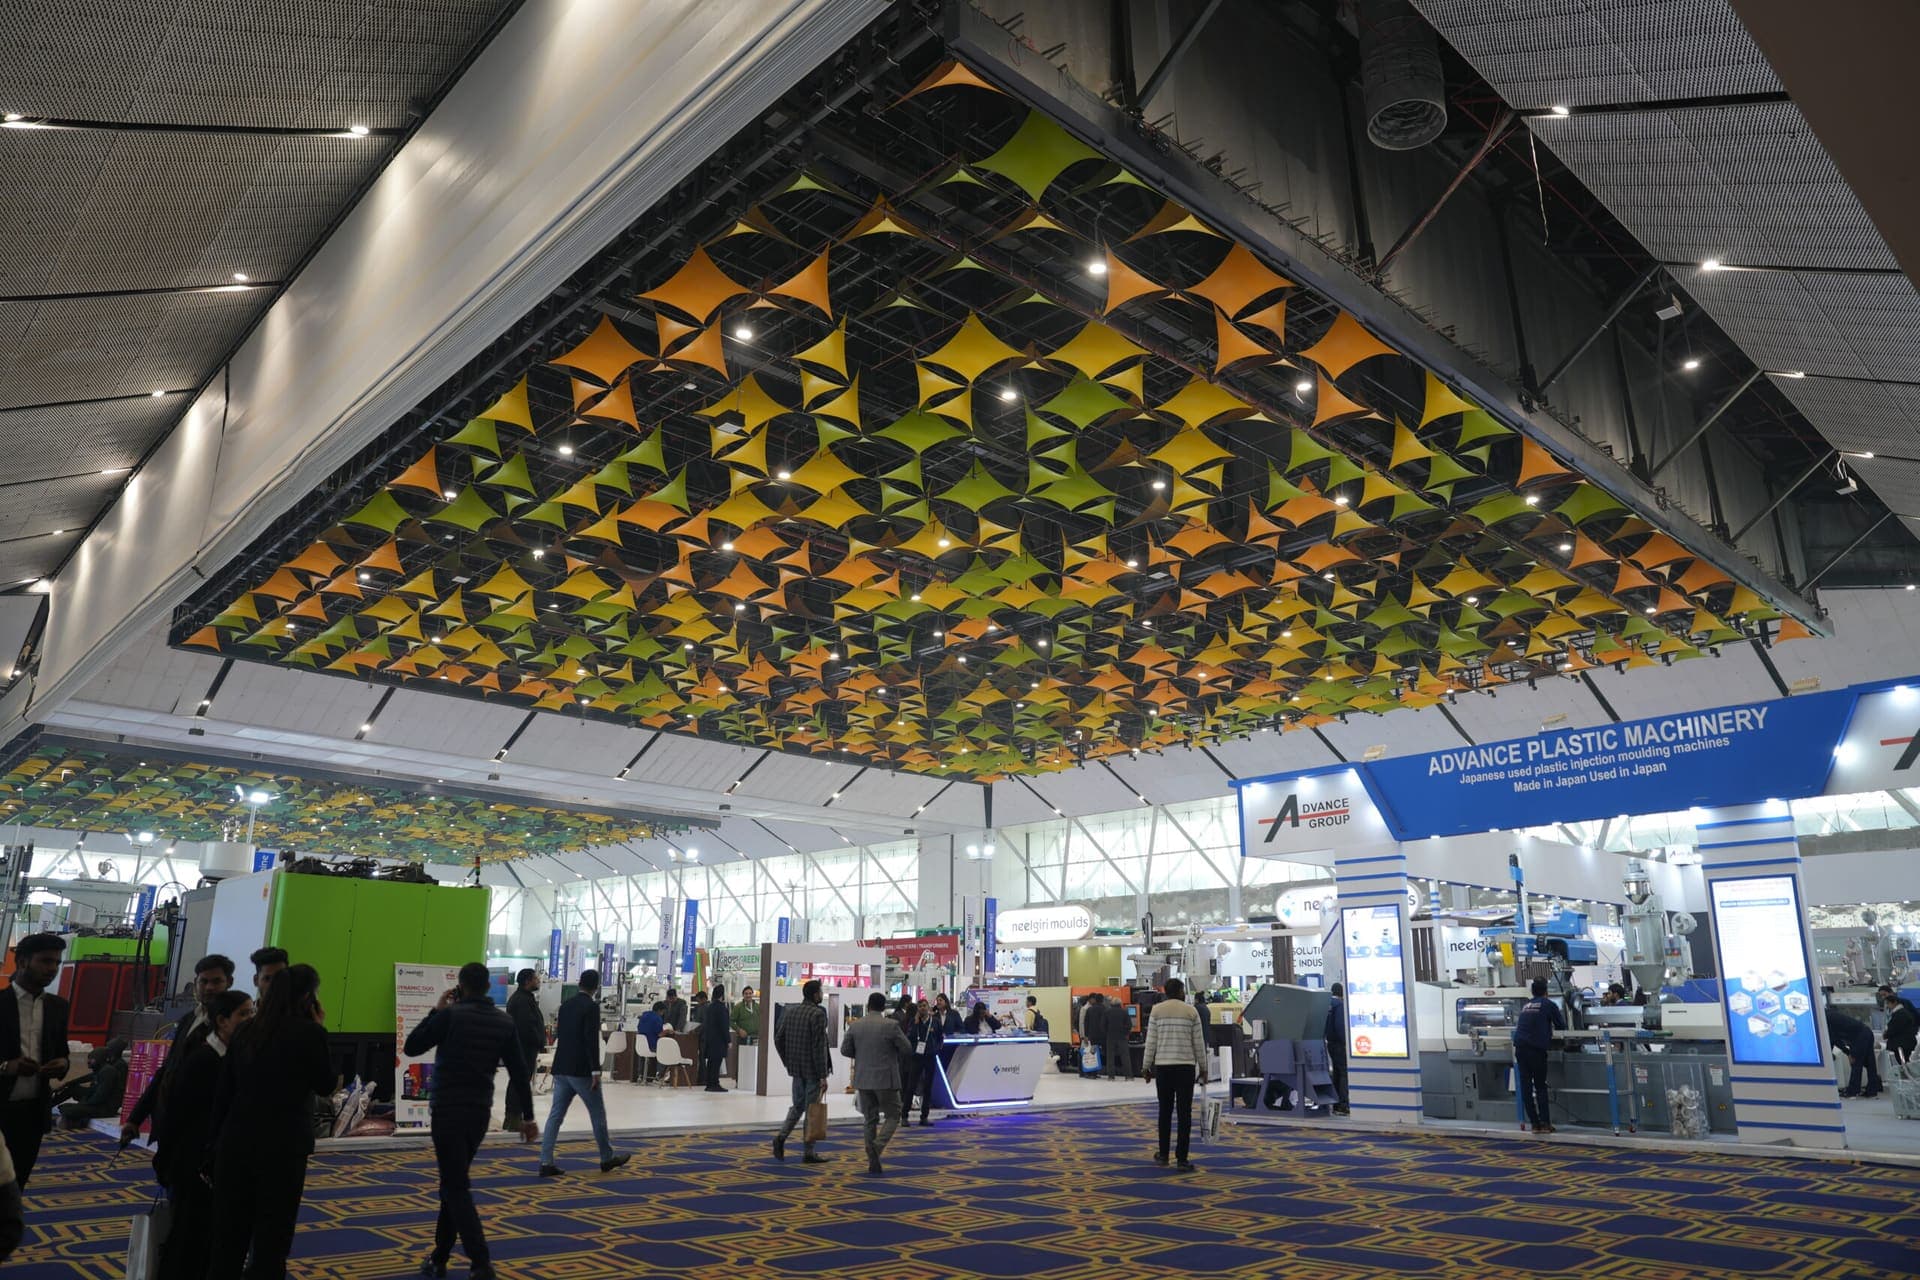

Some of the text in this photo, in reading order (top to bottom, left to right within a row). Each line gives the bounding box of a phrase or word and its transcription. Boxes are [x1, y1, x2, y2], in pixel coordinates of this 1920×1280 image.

[1428, 706, 1768, 776] ADVANCE PLASTIC MACHINERY
[1459, 735, 1730, 785] Japanese used plastic injection moulding machines
[1513, 762, 1667, 793] Made in Japan Used in Japan
[1309, 814, 1350, 829] GROUP
[1012, 916, 1089, 934] neelgiri moulds
[1251, 949, 1268, 958] ONE
[1299, 958, 1323, 967] INDUS
